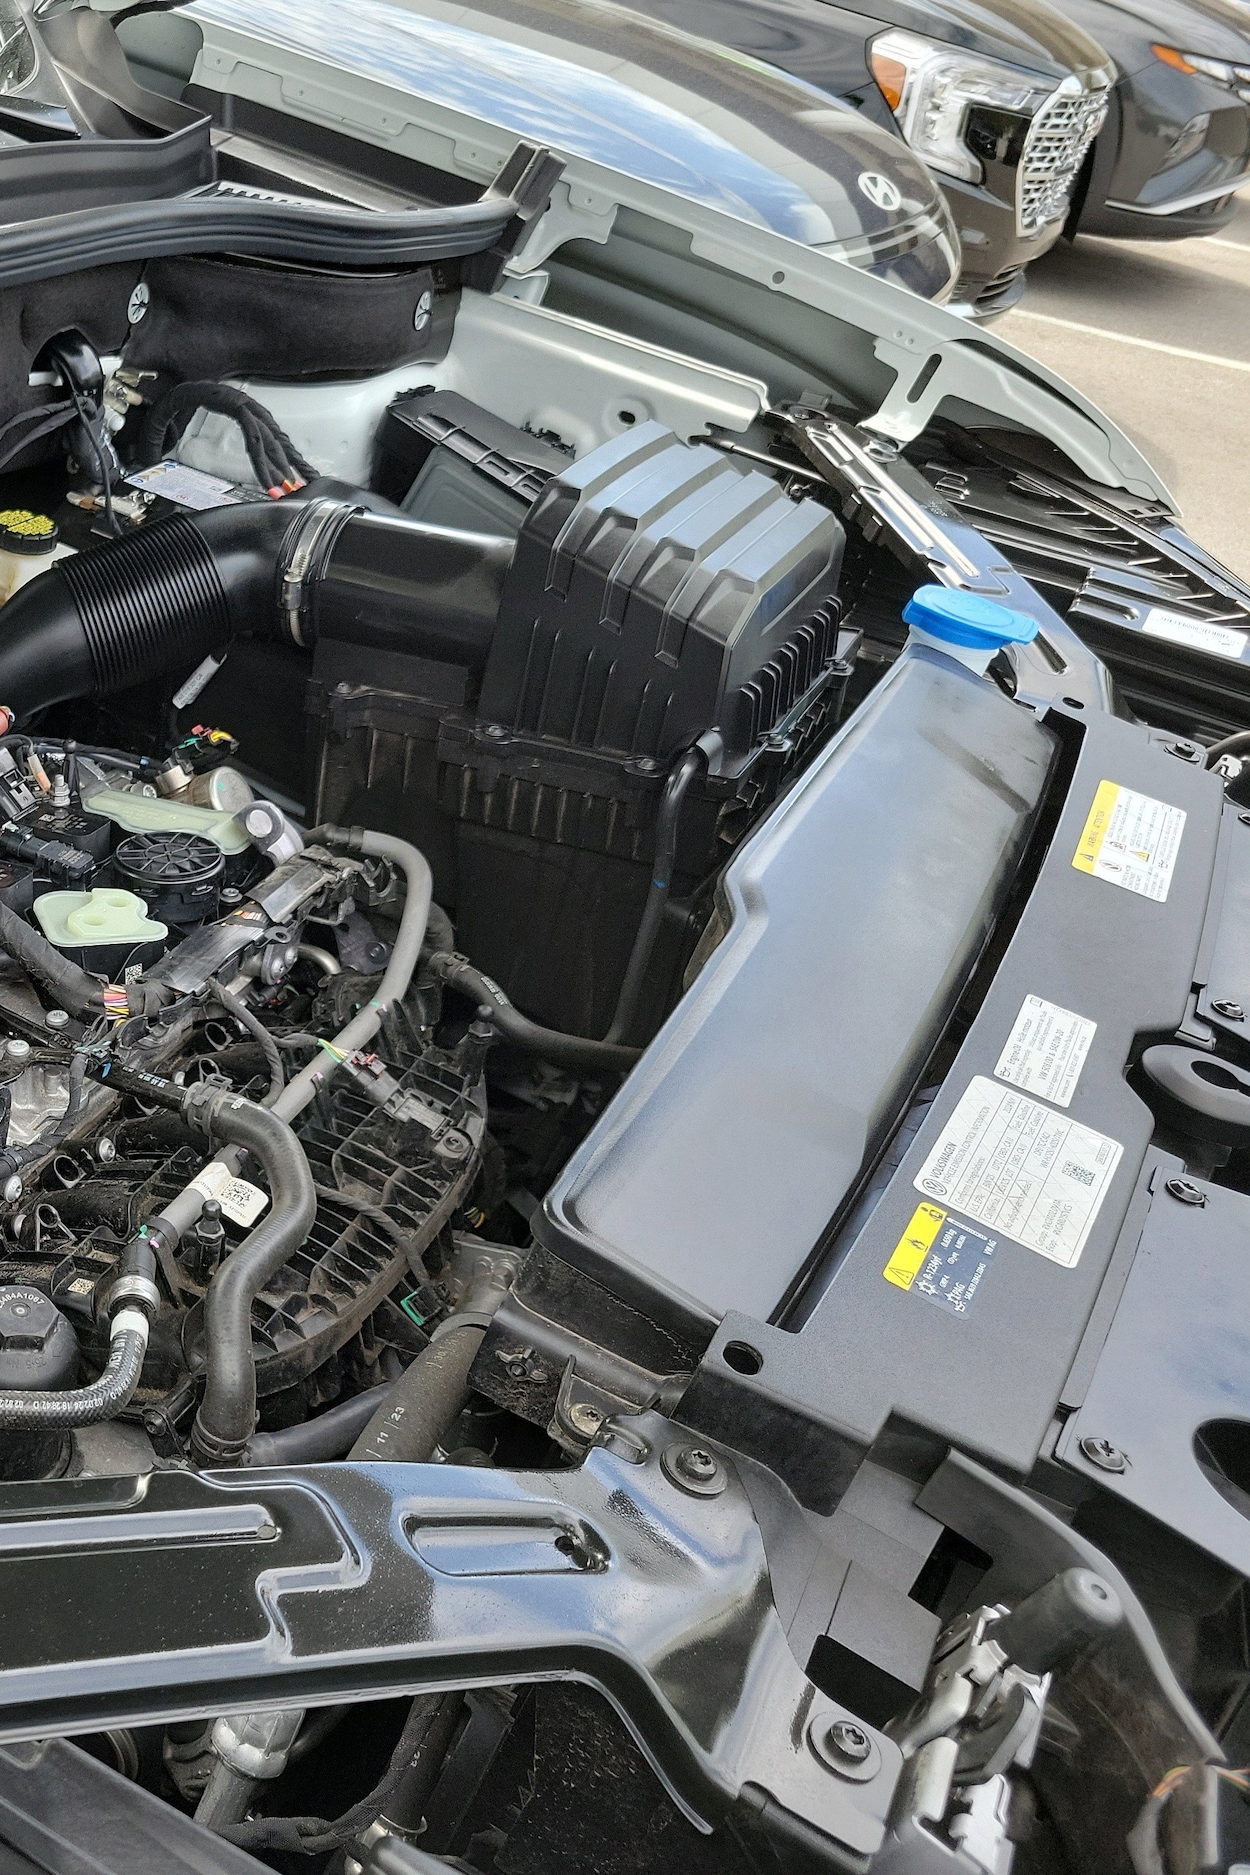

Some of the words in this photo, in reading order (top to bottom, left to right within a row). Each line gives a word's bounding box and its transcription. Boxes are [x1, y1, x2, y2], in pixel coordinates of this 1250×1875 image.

[962, 1130, 977, 1150] CONTROL
[930, 1141, 957, 1180] VOLKSWAGEN
[953, 1282, 965, 1300] PAG
[374, 1429, 390, 1446] 11
[389, 1404, 405, 1423] 23
